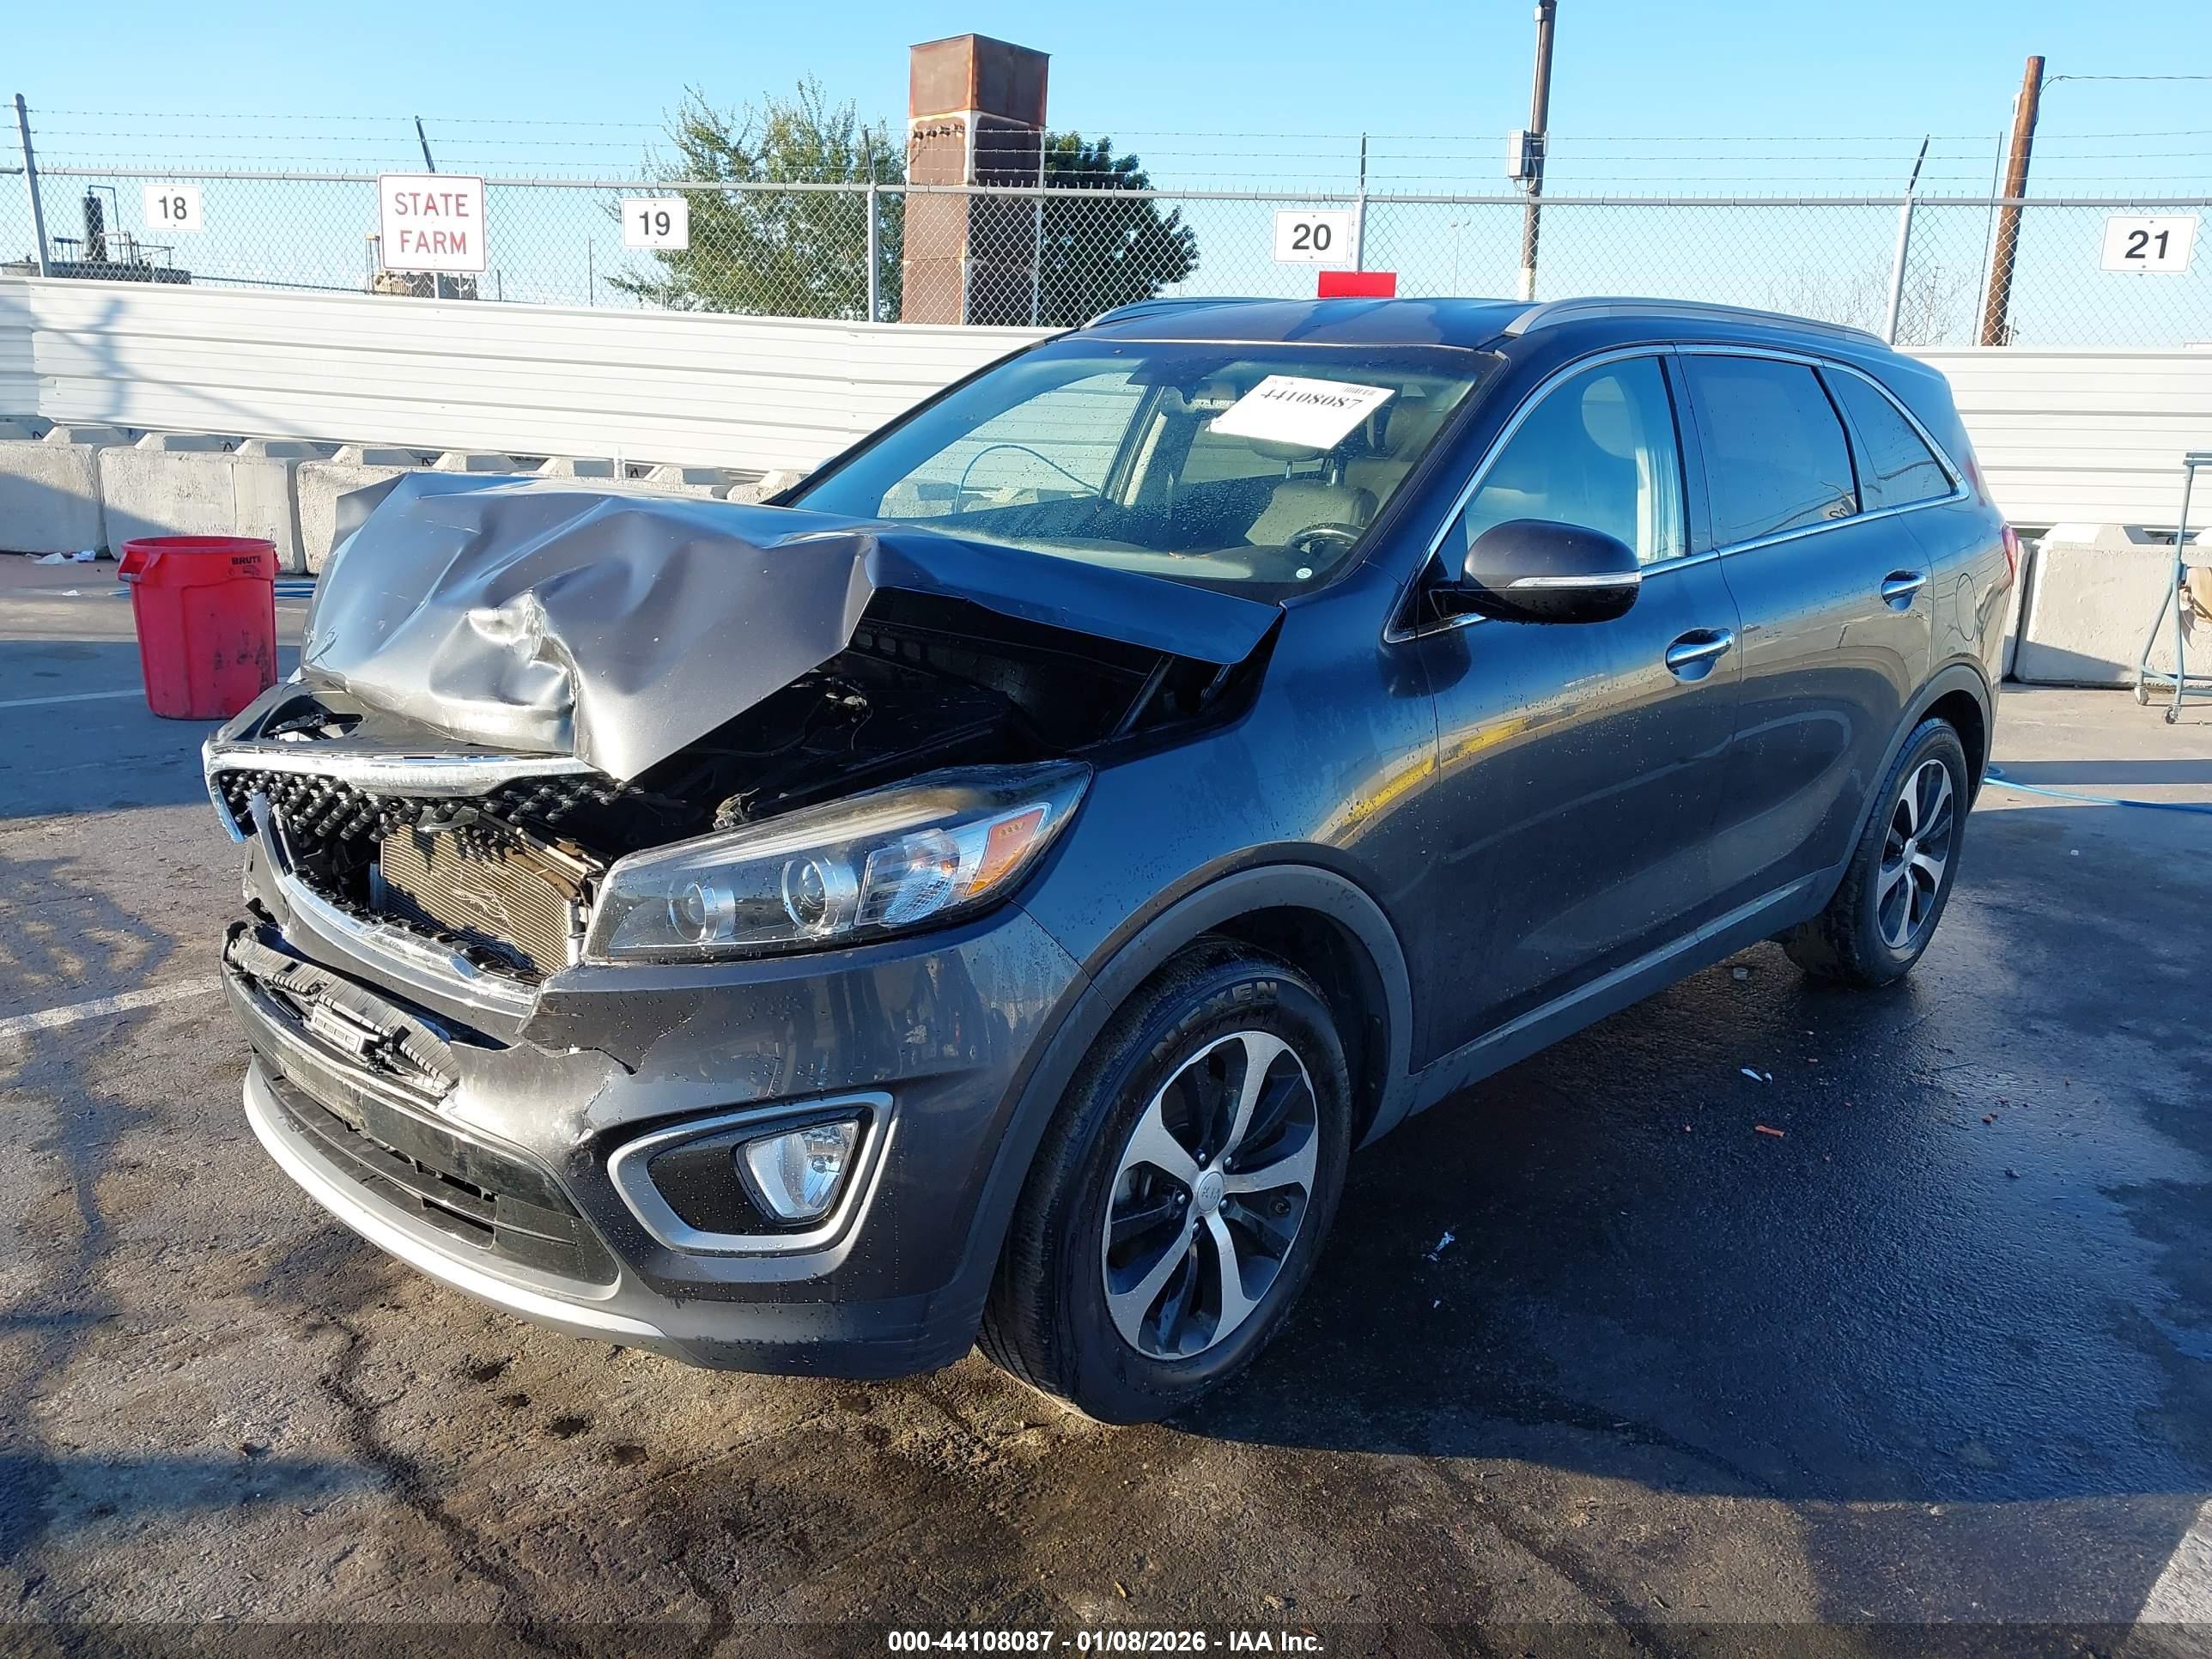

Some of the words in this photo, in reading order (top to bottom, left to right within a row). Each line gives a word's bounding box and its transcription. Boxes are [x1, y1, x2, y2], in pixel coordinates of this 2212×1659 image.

[159, 197, 187, 220] 18
[394, 192, 469, 217] STATE
[640, 211, 671, 236] 19
[399, 230, 466, 255] FARM
[1291, 223, 1332, 251] 20
[2124, 230, 2169, 259] 21
[1261, 388, 1364, 410] 44108087
[232, 556, 262, 565] BRUTE
[1151, 981, 1279, 1063] NEXEN
[1201, 1186, 1220, 1200] KIA
